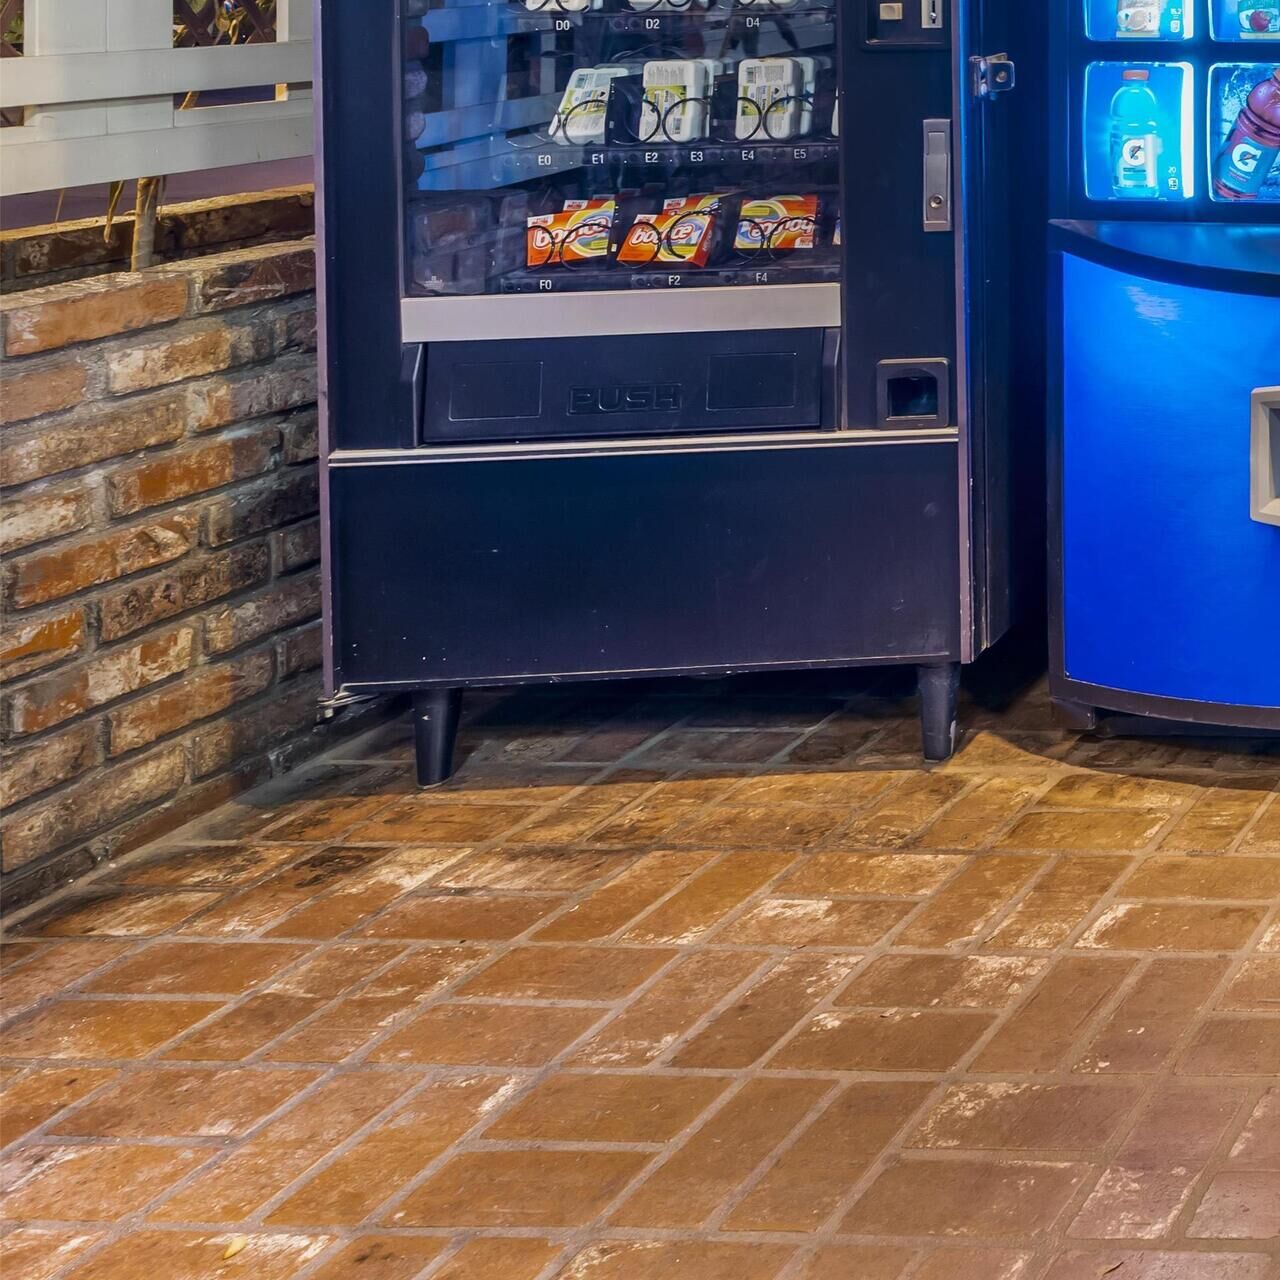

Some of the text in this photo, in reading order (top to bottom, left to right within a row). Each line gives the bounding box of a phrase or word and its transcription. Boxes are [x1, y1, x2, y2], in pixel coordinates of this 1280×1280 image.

[645, 19, 660, 30] D2
[746, 18, 760, 28] D4
[645, 152, 659, 163] E2
[690, 152, 704, 162] E3
[742, 150, 755, 161] E4
[793, 149, 807, 159] E5
[1122, 139, 1145, 166] G
[1232, 143, 1262, 173] G
[592, 154, 605, 165] E1
[668, 275, 681, 286] F2
[755, 272, 768, 283] F4
[570, 386, 680, 411] PUSH
